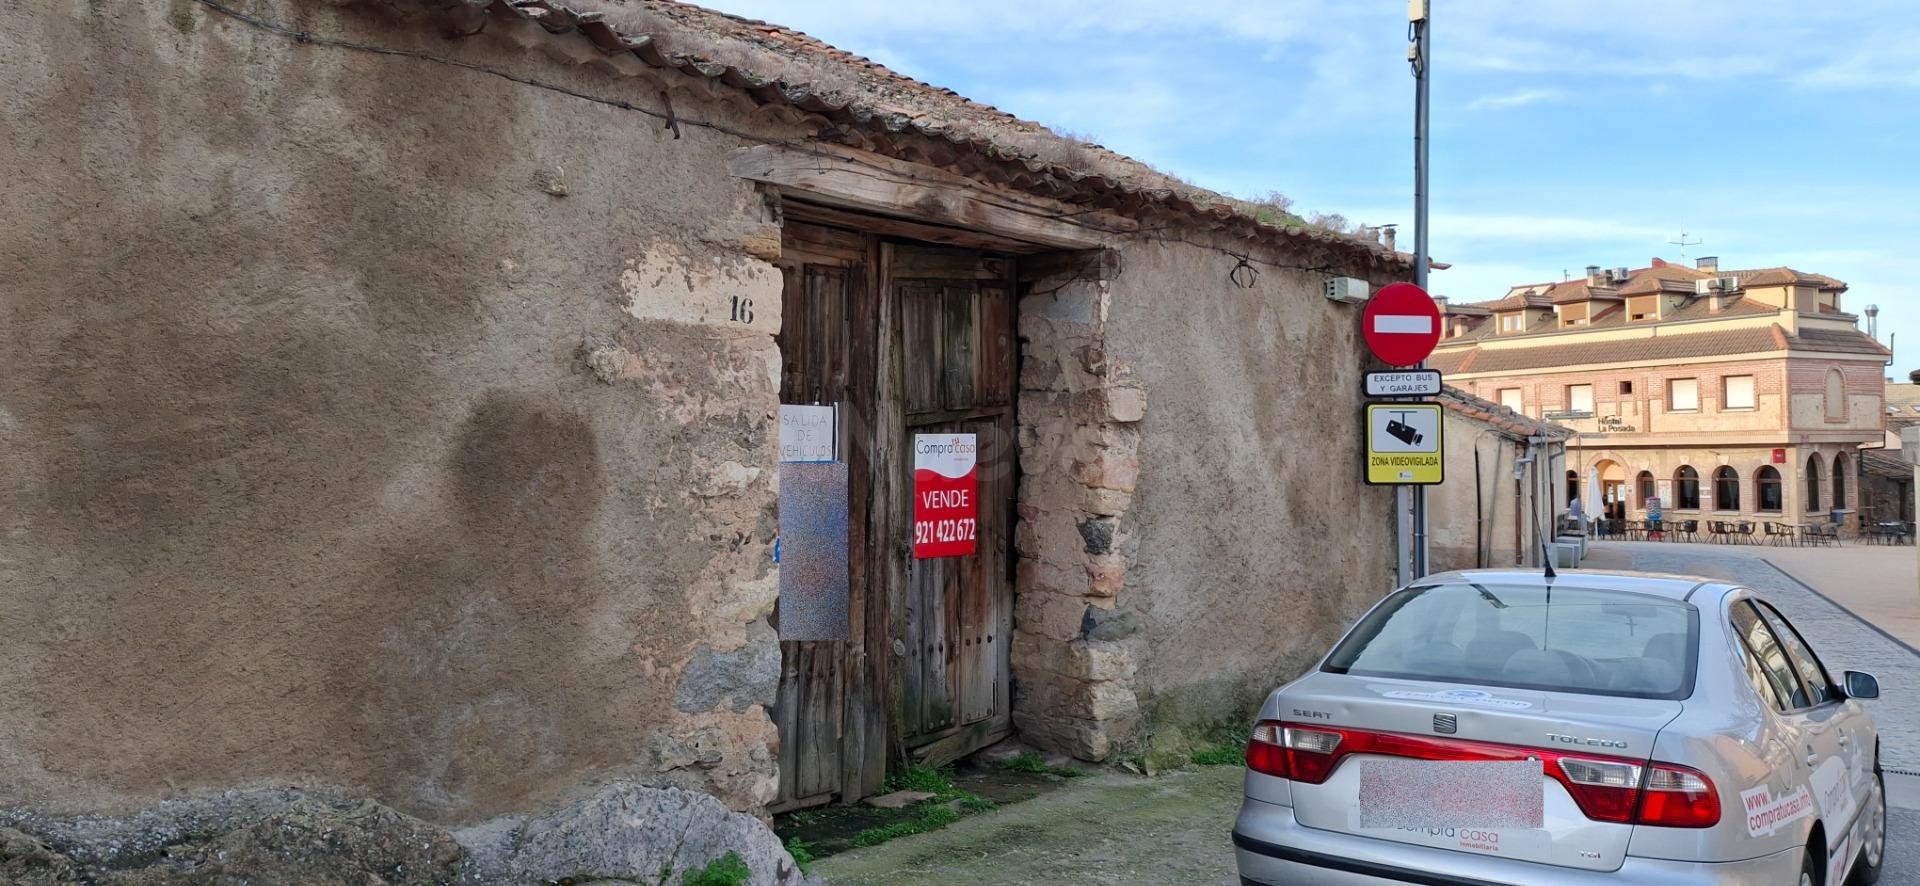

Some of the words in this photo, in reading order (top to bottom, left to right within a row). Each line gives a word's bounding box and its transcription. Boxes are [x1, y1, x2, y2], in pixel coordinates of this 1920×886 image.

[730, 295, 754, 324] 16
[1374, 374, 1412, 382] EXCEPTO
[1389, 384, 1428, 392] GARAJES
[783, 414, 827, 427] SALIDA
[1598, 416, 1622, 425] Hostal
[1608, 424, 1636, 432] Posada
[797, 429, 816, 441] DE
[916, 440, 953, 458] Compra
[1371, 456, 1389, 466] ZONA
[1390, 456, 1439, 466] VIDEOVIGILADA
[922, 489, 969, 509] VENDE
[915, 520, 934, 544] 921
[936, 519, 955, 543] 422
[957, 518, 976, 541] 672
[1292, 708, 1333, 720] SEAT
[1545, 733, 1628, 749] TOLEDO
[1745, 791, 1771, 811] www.
[1460, 828, 1499, 843] casa
